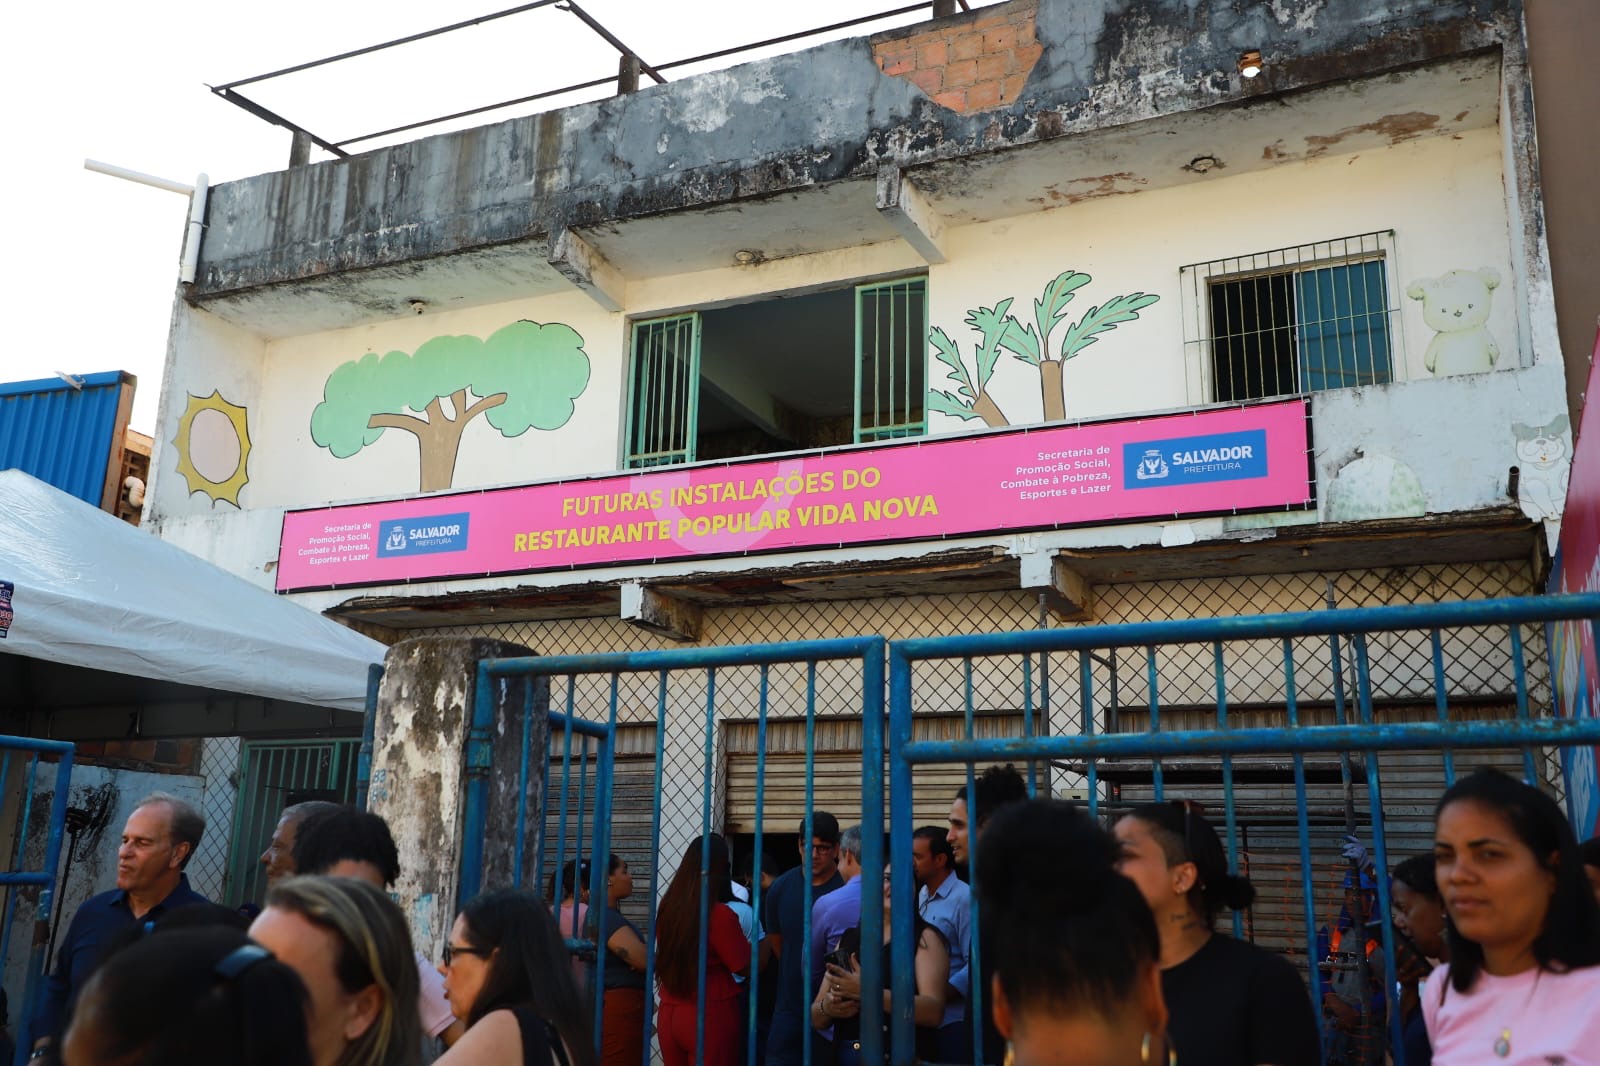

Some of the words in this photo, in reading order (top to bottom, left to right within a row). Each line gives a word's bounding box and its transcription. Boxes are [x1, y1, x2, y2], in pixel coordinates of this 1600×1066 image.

[1038, 448, 1092, 460] Secretaria
[1096, 446, 1110, 454] de
[1172, 446, 1253, 466] SALVADOR
[1016, 462, 1071, 475] Promoção
[1074, 458, 1110, 469] Social,
[1184, 462, 1241, 474] PREFEITURA
[1000, 477, 1049, 489] Combate
[1052, 476, 1059, 484] à
[1062, 472, 1111, 483] Pobreza,
[562, 489, 664, 518] FUTURAS
[669, 470, 835, 507] INSTALAÇÕES
[842, 466, 881, 490] DO
[1020, 488, 1068, 500] Esportes
[1080, 484, 1112, 494] Lazer
[324, 524, 360, 533] Secretaria
[362, 522, 372, 530] de
[514, 519, 671, 553] RESTAURANTE
[677, 507, 790, 539] POPULAR
[797, 502, 857, 527] VIDA
[863, 494, 939, 522] NOVA
[309, 535, 345, 545] Promoção
[346, 532, 371, 541] Social,
[409, 524, 460, 540] SALVADOR
[298, 546, 330, 556] Combate
[338, 543, 370, 552] Pobreza,
[416, 538, 452, 547] PREFEITURA
[310, 556, 340, 565] Esportes
